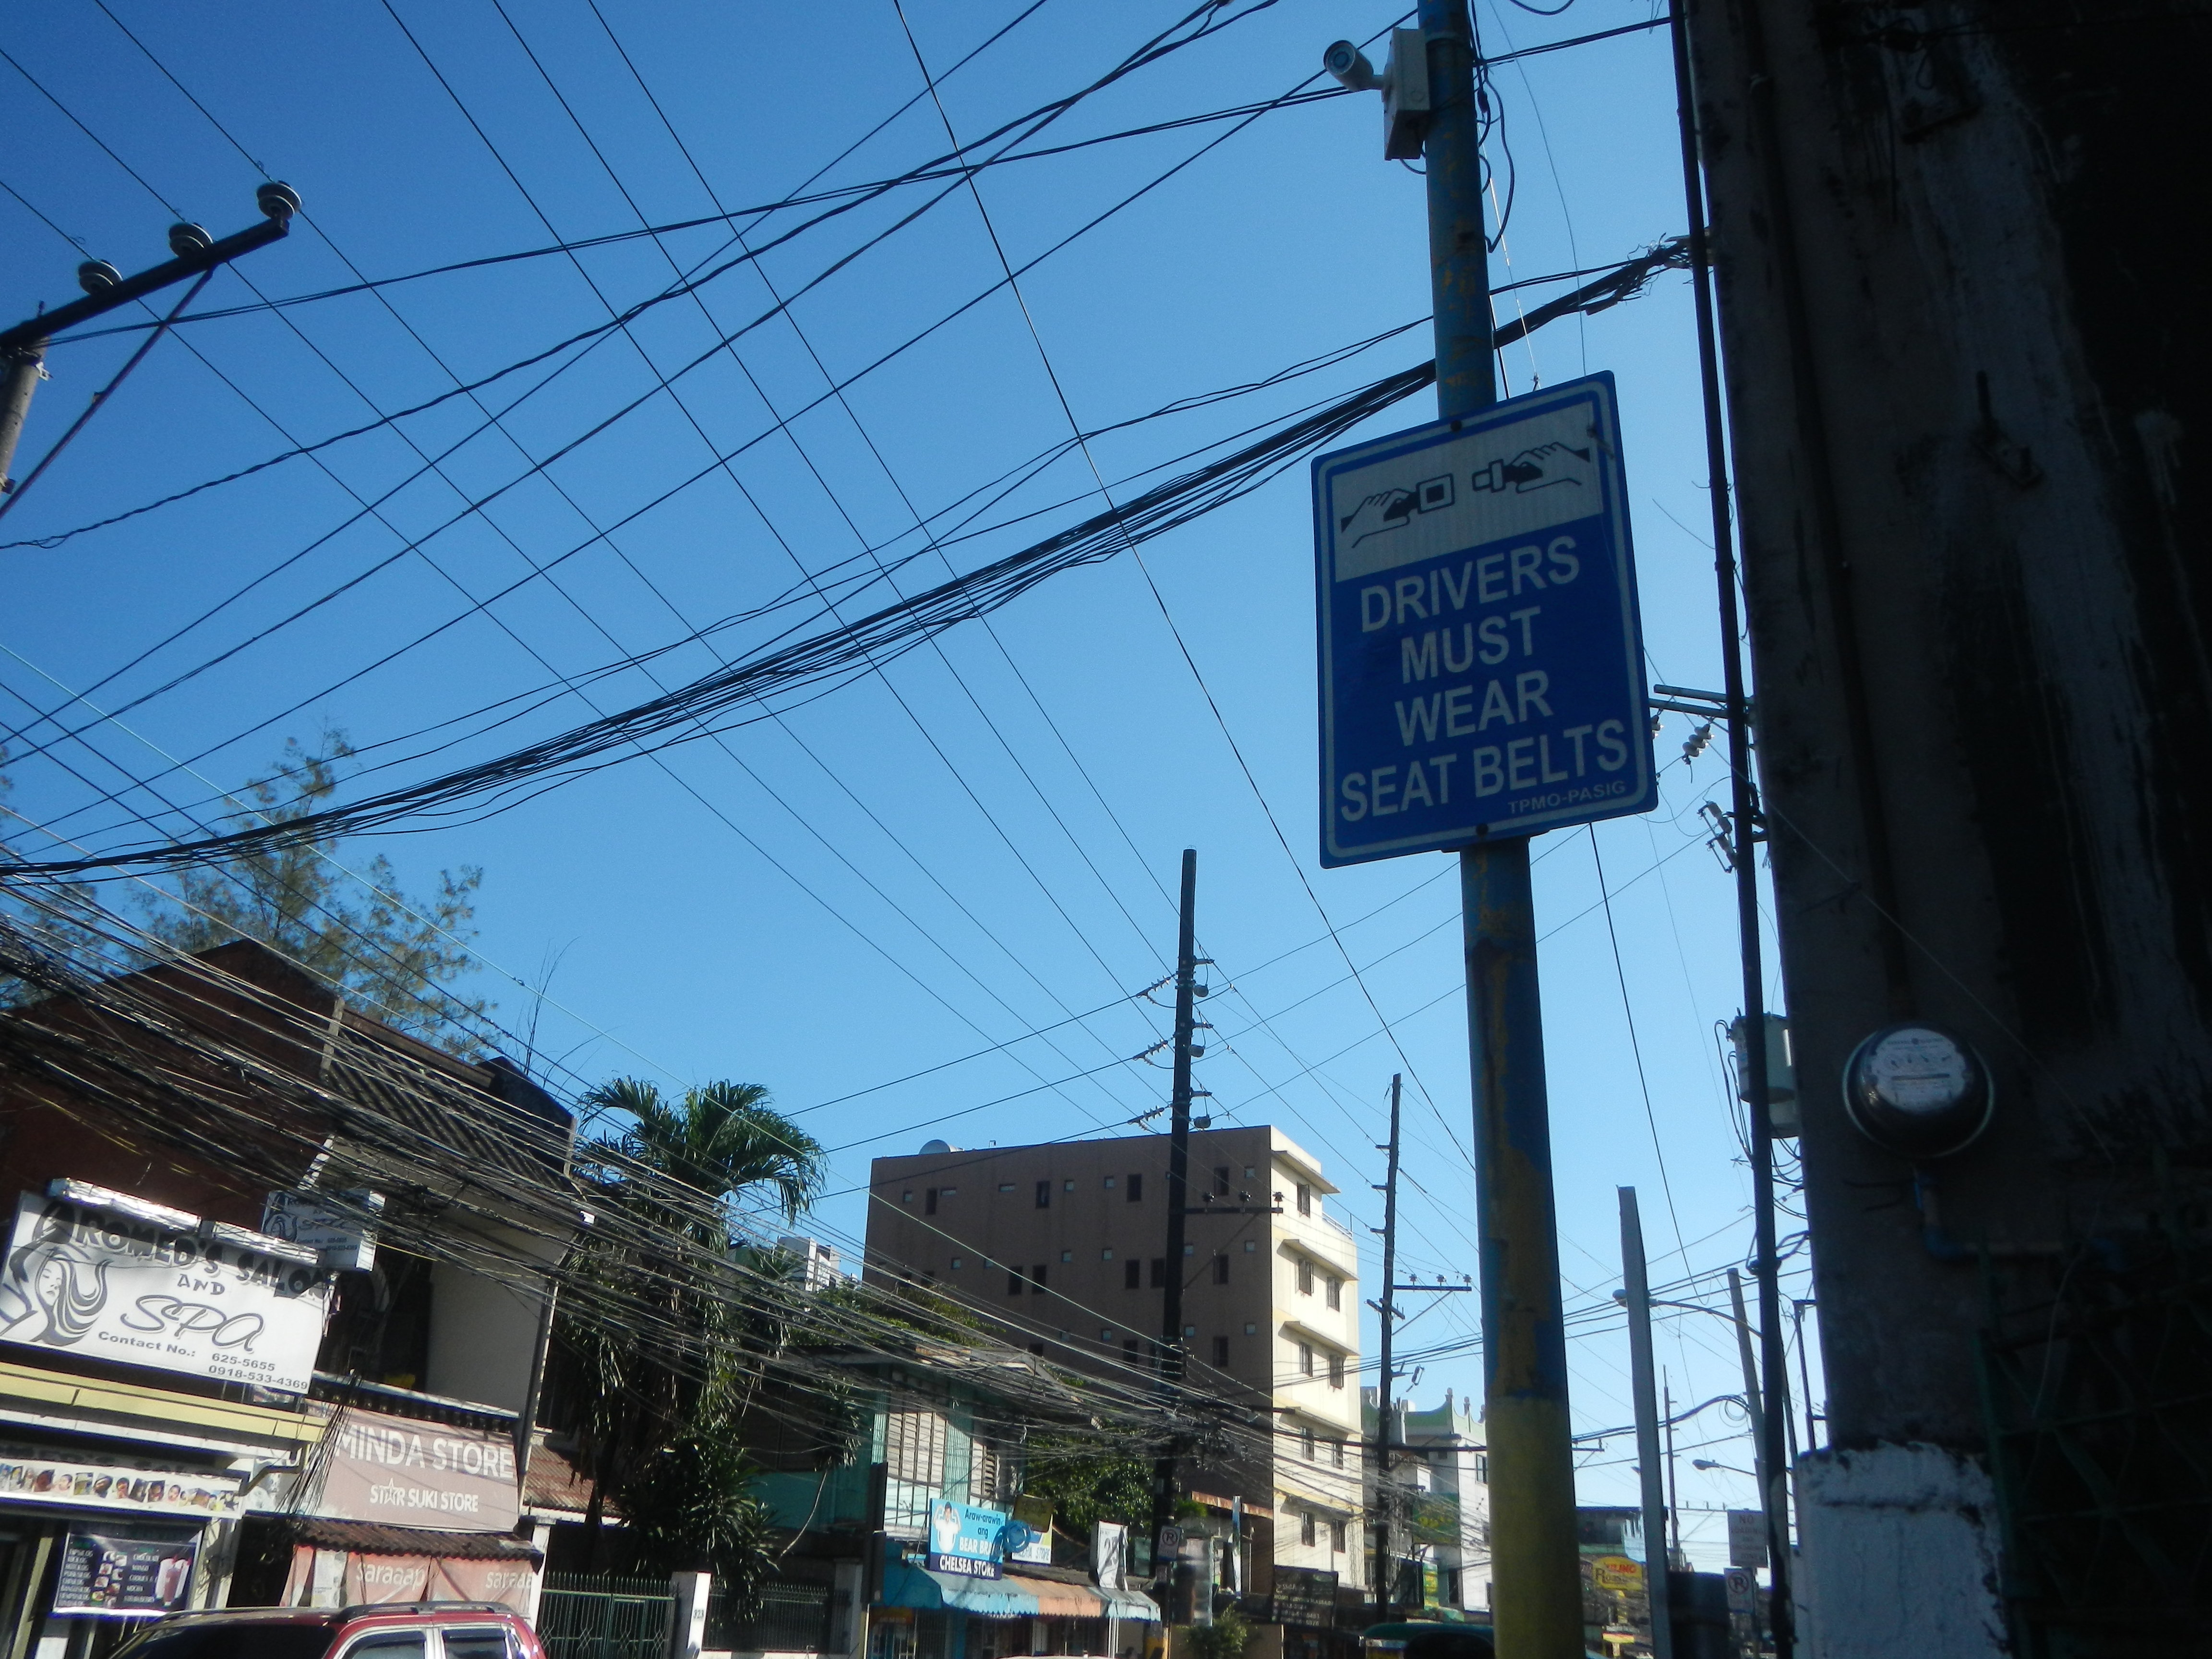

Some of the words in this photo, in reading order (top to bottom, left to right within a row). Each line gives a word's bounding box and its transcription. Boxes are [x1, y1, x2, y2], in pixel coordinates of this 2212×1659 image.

[1360, 535, 1580, 633] DRIVERS
[1401, 606, 1542, 684] MUST
[1395, 670, 1553, 746] WEAR
[1340, 753, 1456, 822] SEAT
[1474, 718, 1628, 798] BELTS
[1508, 780, 1626, 816] TPMO-PASIG
[177, 1273, 226, 1296] AND
[98, 1331, 162, 1351] Contact
[165, 1344, 196, 1358] No.:
[211, 1352, 276, 1372] 625-5655
[208, 1364, 308, 1390] 0918-533-4369
[334, 1423, 425, 1469] MINDA
[432, 1437, 515, 1479] STORE
[407, 1488, 438, 1510] SUKI
[440, 1492, 479, 1513] STORE
[964, 1508, 1001, 1526] Araw-arawin
[1739, 1515, 1754, 1525] NO
[977, 1527, 988, 1539] ang
[959, 1537, 978, 1553] BEAR
[979, 1540, 993, 1555] BRA
[939, 1555, 972, 1574] CHELSEA
[974, 1560, 995, 1577] STORE
[693, 1609, 704, 1619] 323
